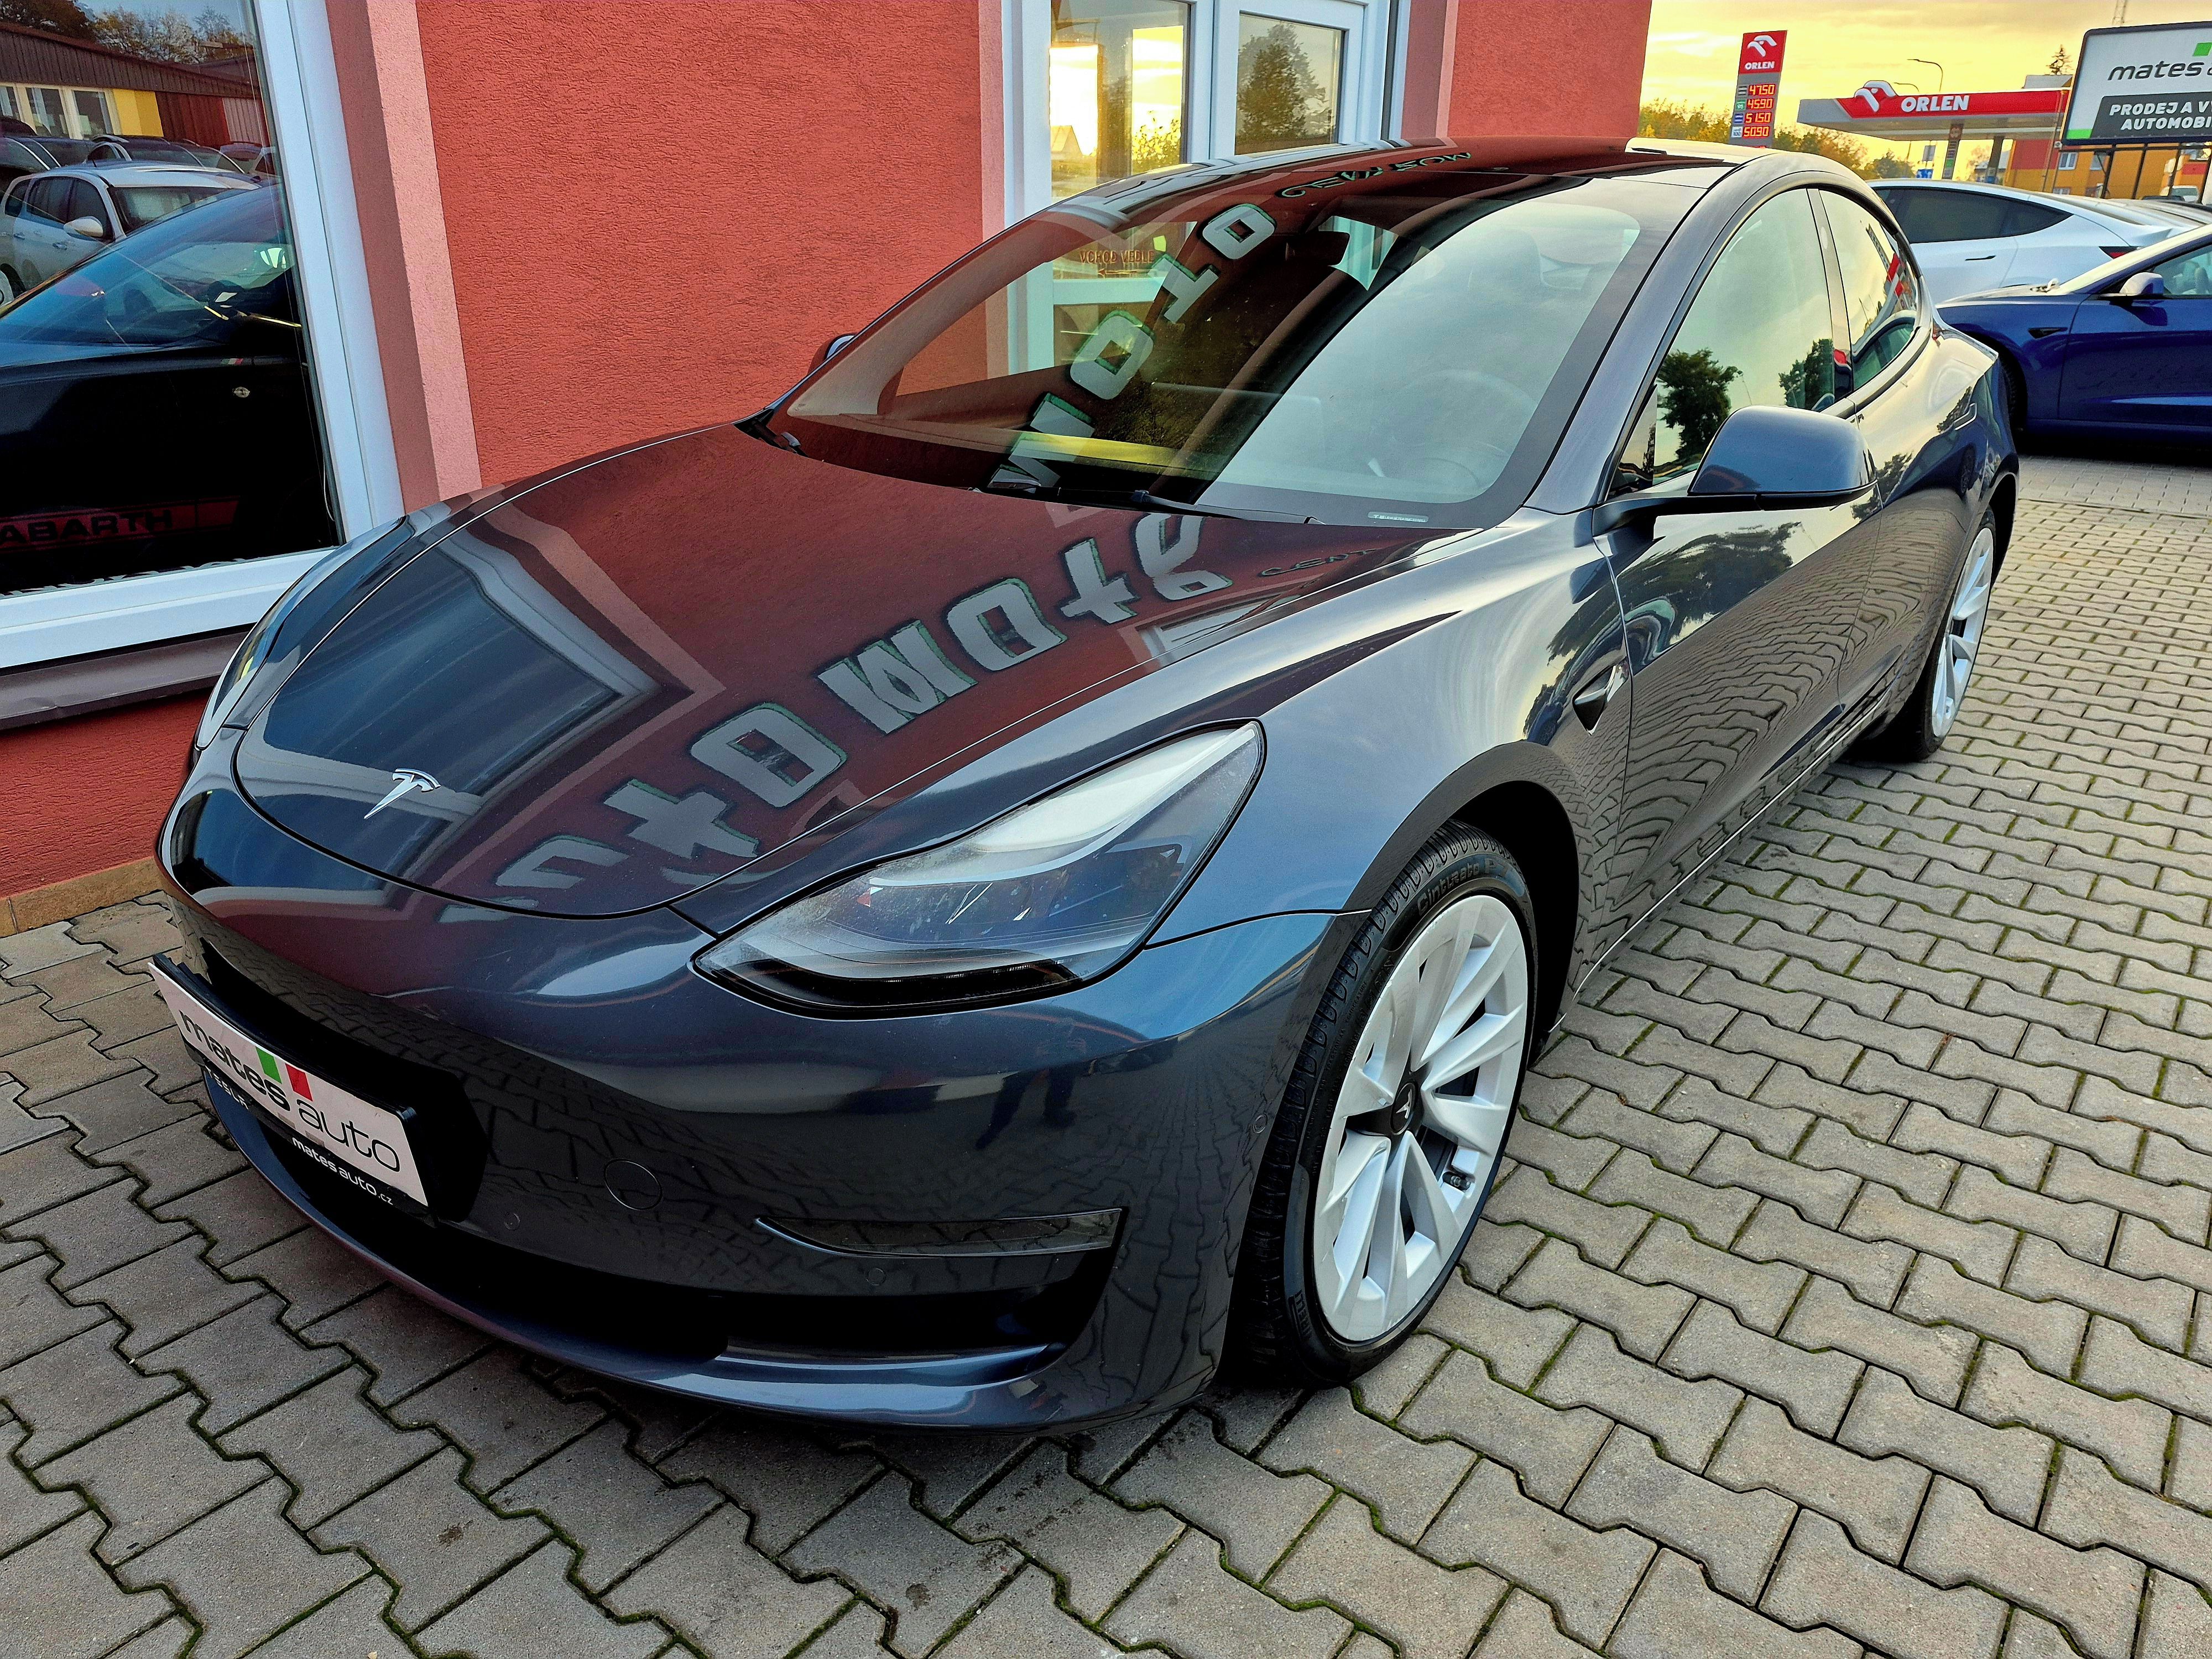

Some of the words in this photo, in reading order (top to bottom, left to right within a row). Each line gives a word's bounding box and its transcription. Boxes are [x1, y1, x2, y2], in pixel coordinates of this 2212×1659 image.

[1745, 61, 1775, 70] ORLEN
[2107, 60, 2205, 81] mates
[1747, 98, 1773, 109] 4590
[1901, 95, 1970, 113] ORLEN
[2109, 102, 2179, 116] PRODEJ
[2180, 101, 2192, 114] A
[2120, 116, 2212, 131] AUTOMOBI
[1079, 250, 1118, 264] VCHOD
[1120, 250, 1155, 264] VEDLE
[0, 509, 173, 545] ABARTH
[1416, 862, 1481, 916] Cinturato
[178, 1009, 291, 1112] mates
[296, 1098, 400, 1172] auto
[204, 1065, 250, 1110] TESLA
